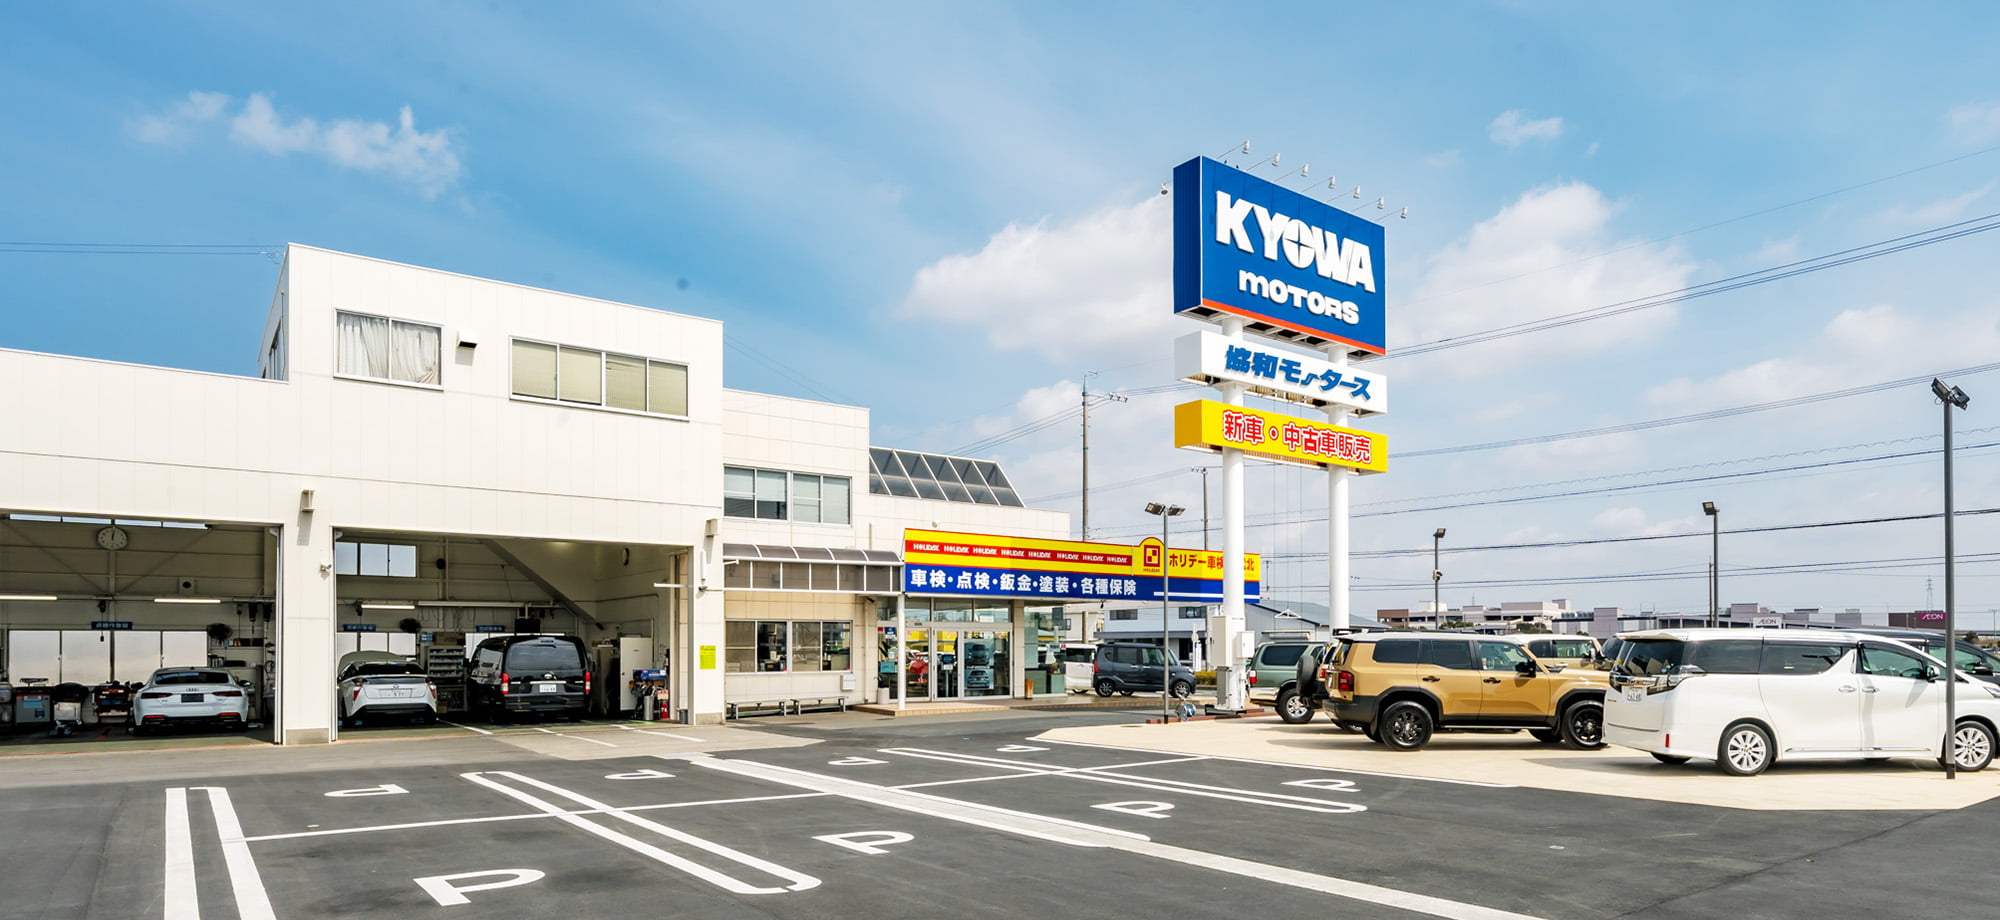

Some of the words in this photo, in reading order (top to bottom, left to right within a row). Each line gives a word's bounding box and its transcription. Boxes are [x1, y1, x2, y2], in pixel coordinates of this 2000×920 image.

[1215, 190, 1376, 293] KYOWA
[1225, 344, 1371, 400] 協和モータース
[1223, 410, 1372, 464] 新車・中古車販売
[913, 543, 940, 551] HOLIDAY
[943, 545, 970, 553] HOLIDAY
[973, 547, 998, 555] HOLIDAY
[1001, 549, 1025, 557] HOLIDAY
[1056, 552, 1080, 560] HOLIDAY
[1082, 554, 1104, 562] HOLIDAY
